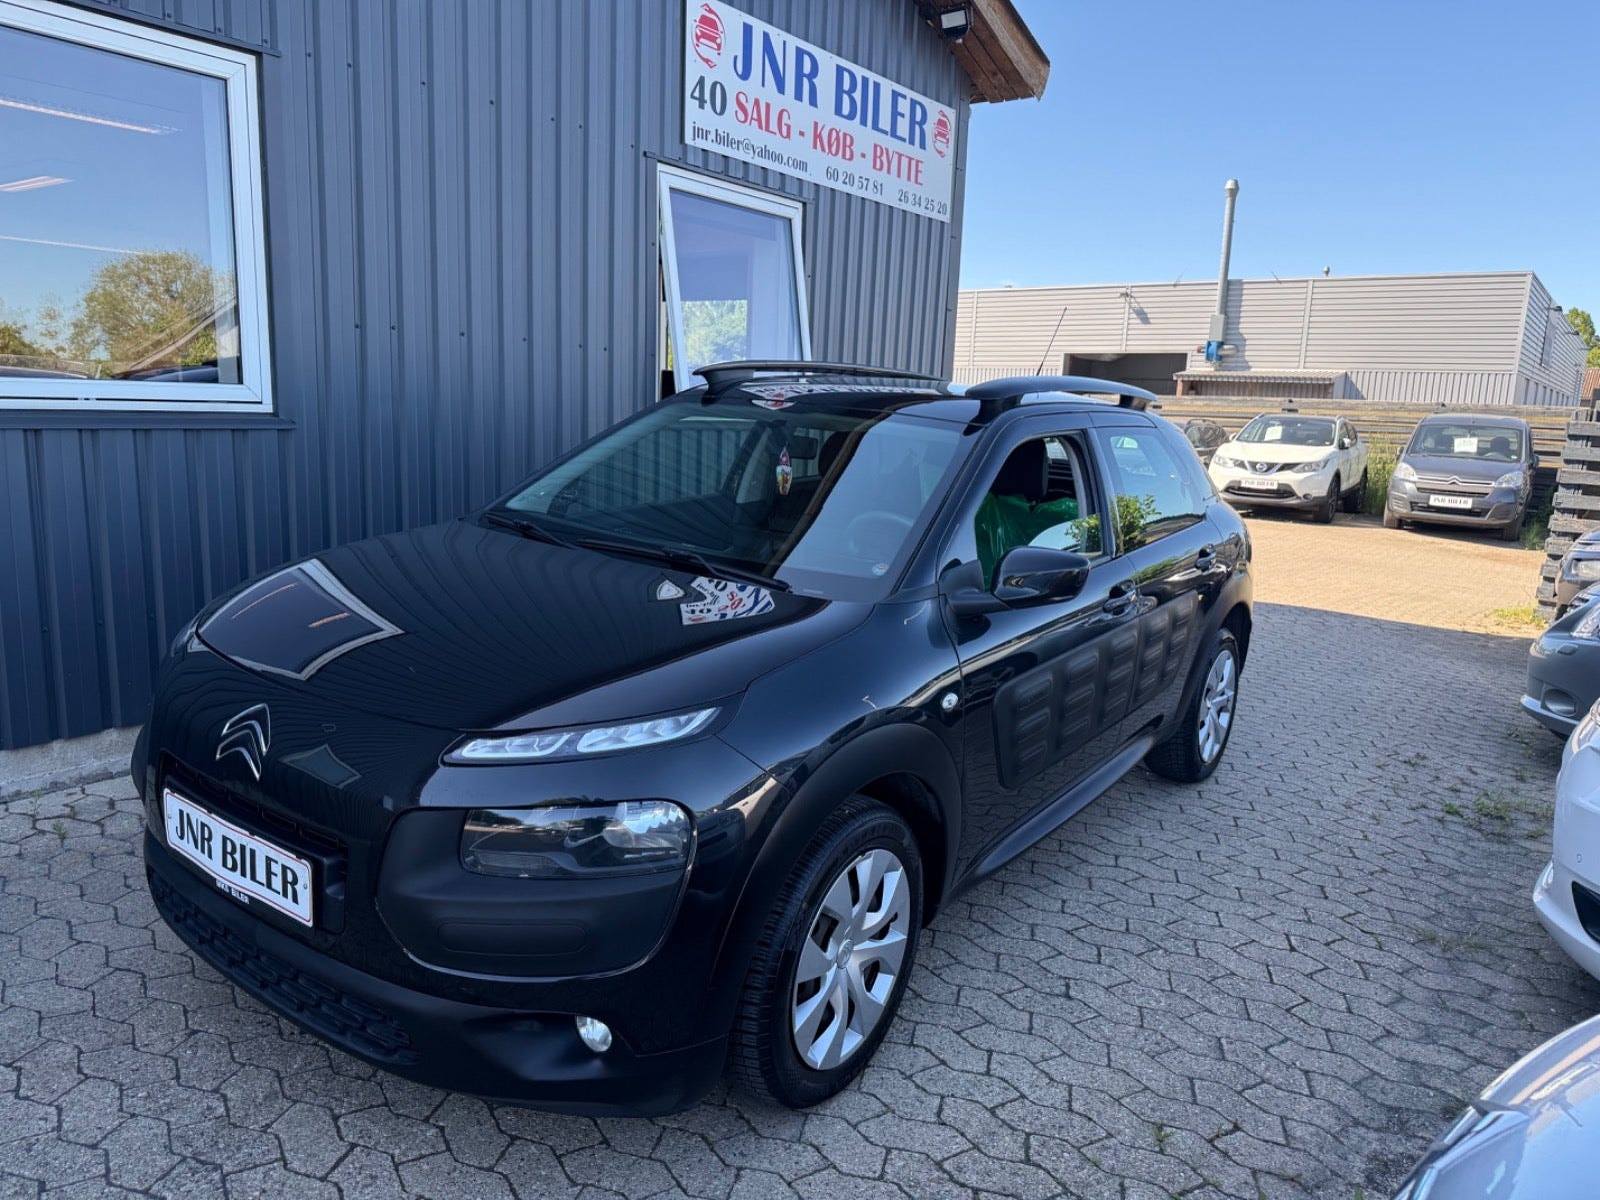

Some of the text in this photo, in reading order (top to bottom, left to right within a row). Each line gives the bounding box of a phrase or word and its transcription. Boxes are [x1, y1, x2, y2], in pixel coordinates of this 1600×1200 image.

[690, 75, 728, 117] 40
[733, 21, 928, 151] JNR BILER
[692, 121, 808, 173] jnr.biler@yahoo.com
[735, 91, 792, 140] SALG
[812, 121, 855, 162] KØB
[872, 143, 924, 186] BYTTE
[826, 165, 883, 196] 60 20 57 81
[898, 188, 948, 216] 26 34 25 20
[175, 808, 300, 906] JNR BILER
